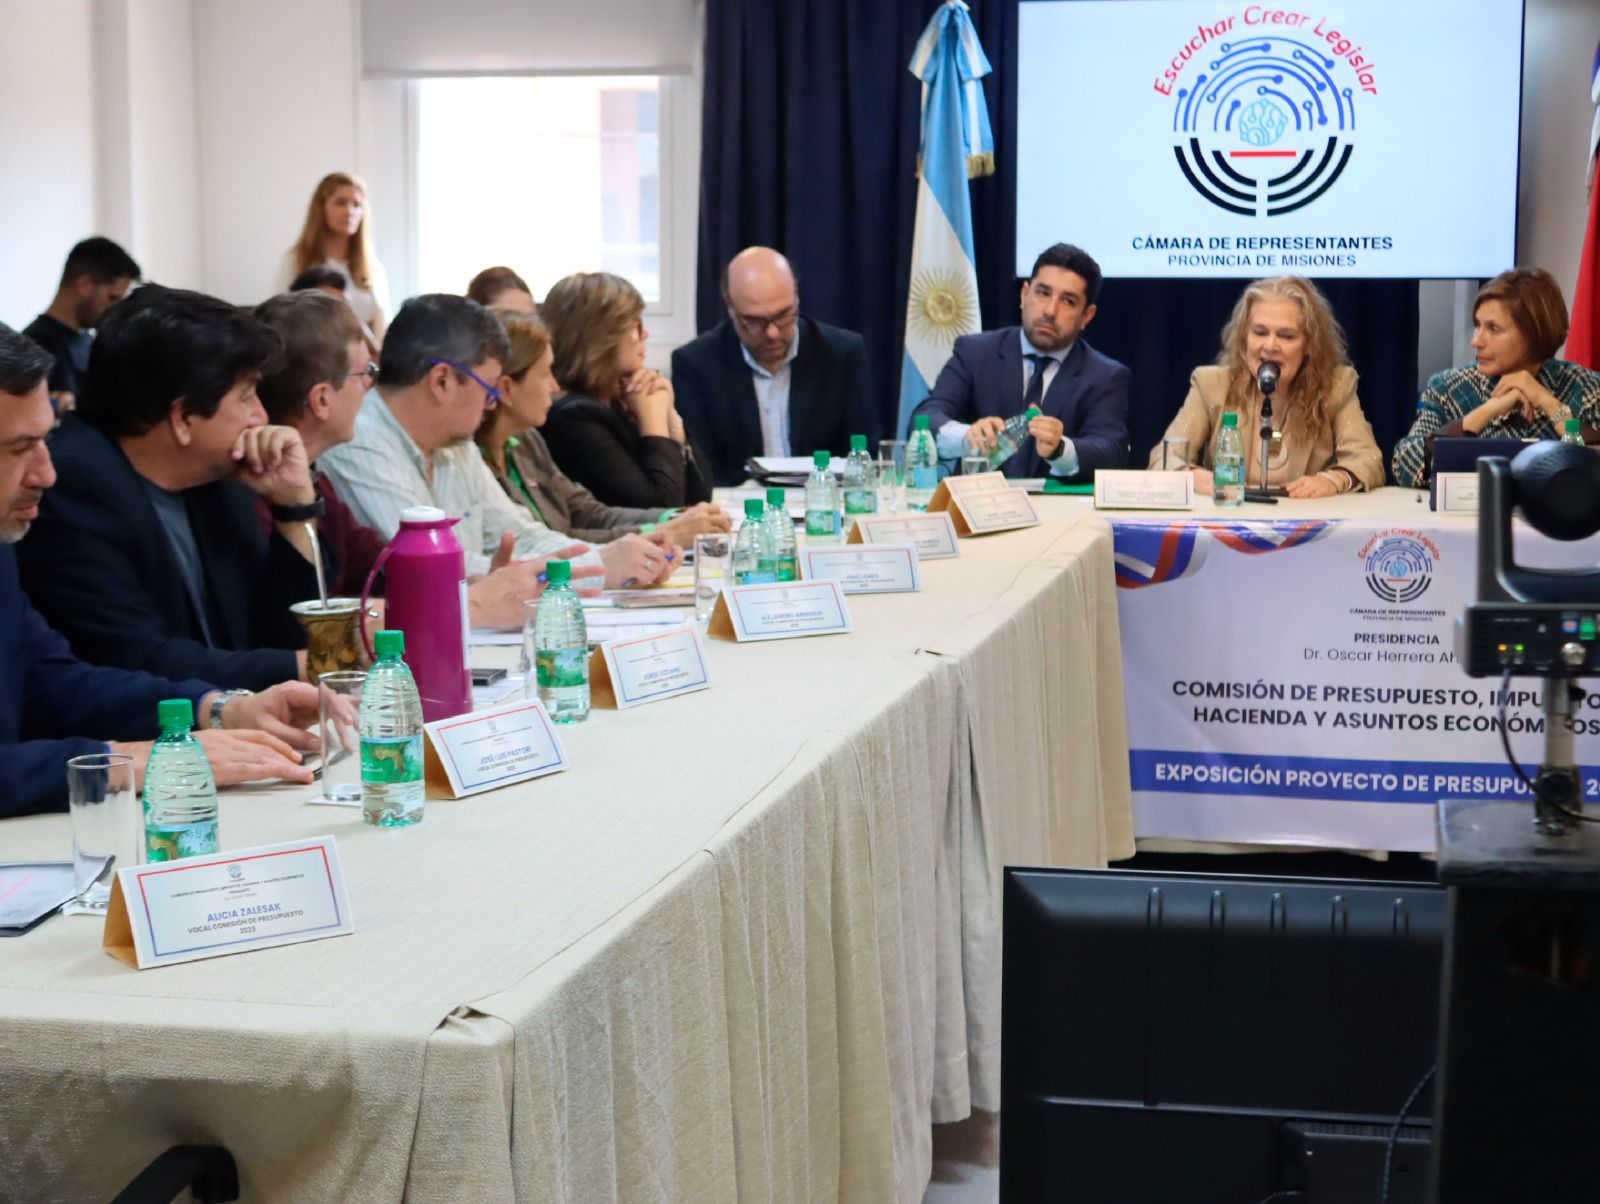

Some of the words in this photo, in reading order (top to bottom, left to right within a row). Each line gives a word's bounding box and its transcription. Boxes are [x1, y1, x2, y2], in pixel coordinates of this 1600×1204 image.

[1153, 15, 1236, 96] Escuchar
[1243, 5, 1310, 28] Crear
[1312, 17, 1377, 95] Legislar
[1132, 234, 1204, 250] CÁMARA
[1209, 237, 1231, 250] DE
[1236, 237, 1393, 250] REPRESENTANTES
[1168, 254, 1252, 267] PROVINCIA
[1256, 254, 1276, 267] DE
[1281, 254, 1357, 267] MISIONES
[1354, 632, 1440, 645] PRESIDENCIA
[1304, 648, 1324, 660] Dr.
[1327, 648, 1373, 662] Oscar
[1377, 650, 1435, 663] Herrera
[1172, 678, 1284, 700] COMISIÓN
[1290, 685, 1318, 701] DE
[1323, 685, 1484, 709] PRESUPUESTO,
[1193, 706, 1307, 726] HACIENDA
[1312, 711, 1327, 727] Y
[1332, 711, 1438, 731] ASUNTOS
[1155, 763, 1281, 785] EXPOSICIÓN
[1286, 769, 1398, 791] PROYECTO
[1402, 775, 1429, 791] DE
[187, 925, 212, 934] VOCAL
[212, 918, 248, 930] COMISIÓN
[248, 916, 258, 925] DE
[257, 910, 304, 923] PRESUPUESTO
[207, 910, 239, 922] ALICIA
[240, 902, 282, 917] ZALESAK
[239, 926, 257, 935] 2025
